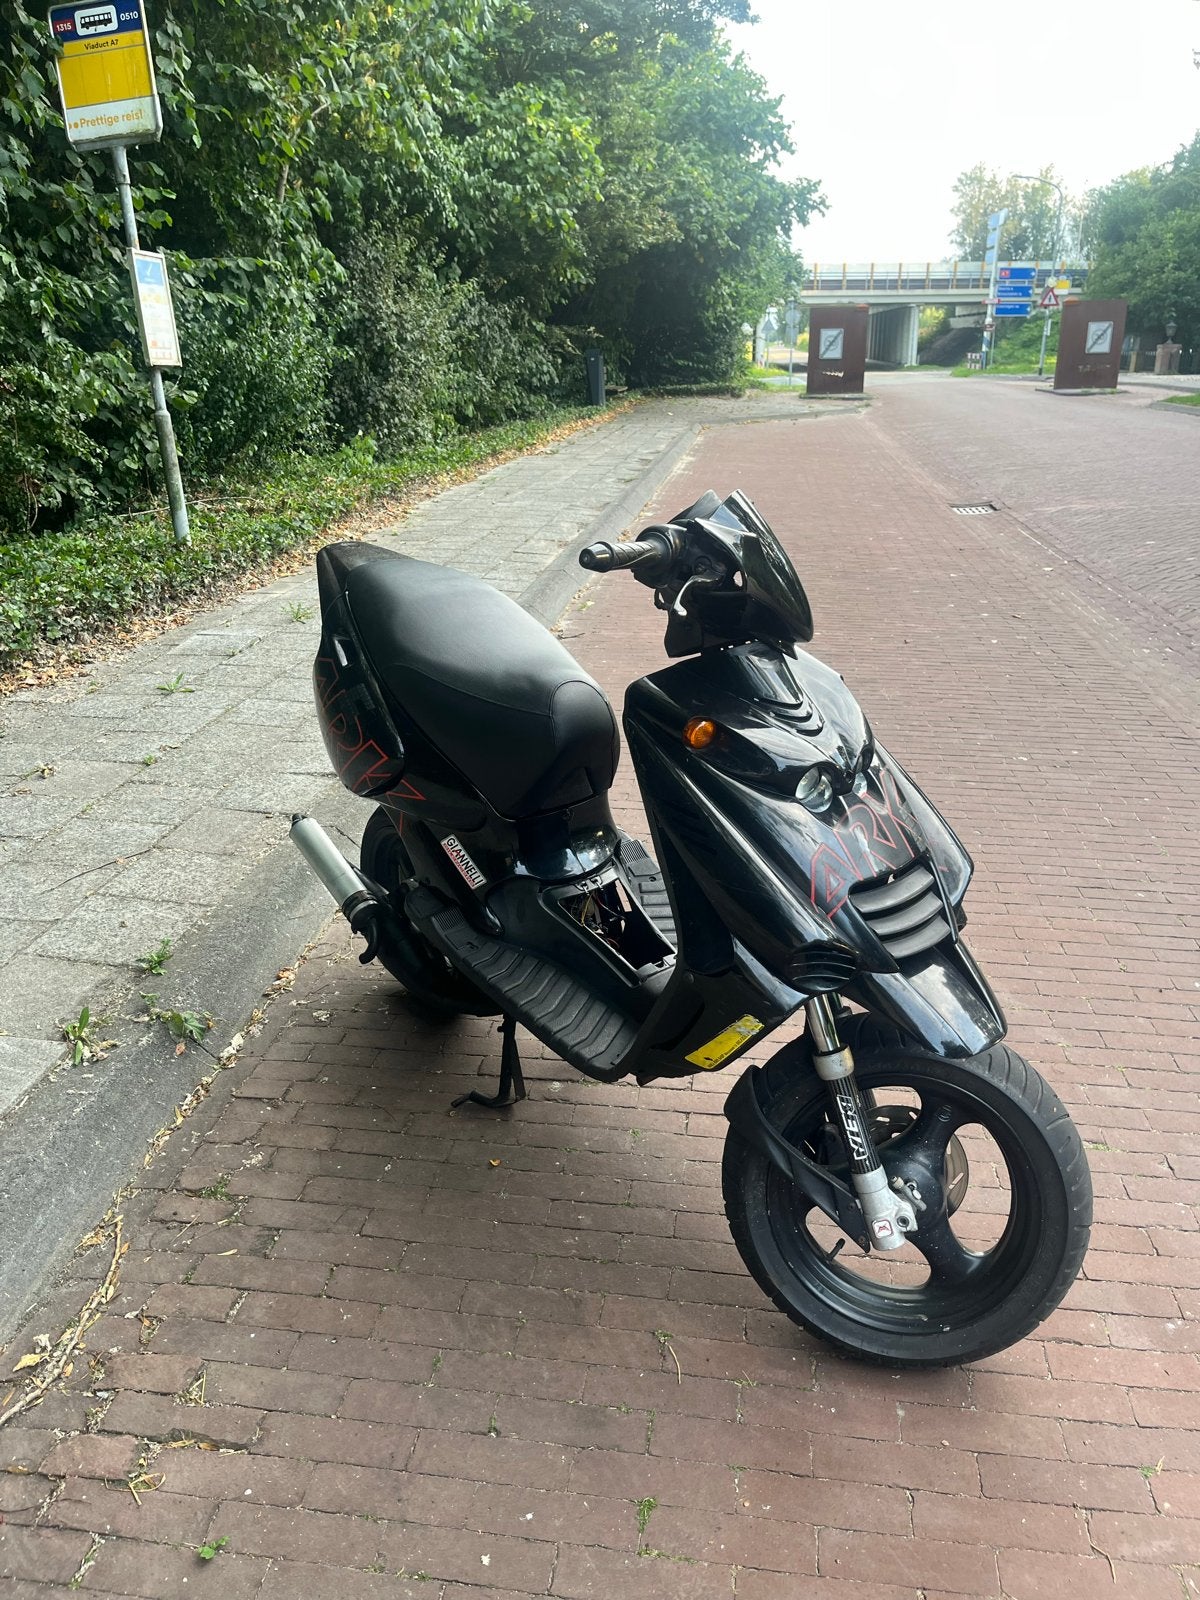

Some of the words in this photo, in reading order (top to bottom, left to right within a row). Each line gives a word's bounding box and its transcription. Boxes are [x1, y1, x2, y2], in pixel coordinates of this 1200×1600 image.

[120, 11, 139, 21] 0510
[84, 41, 109, 50] Viaduct
[80, 115, 119, 127] Prettige
[121, 109, 144, 121] reis!
[446, 836, 484, 887] GIANNELLI
